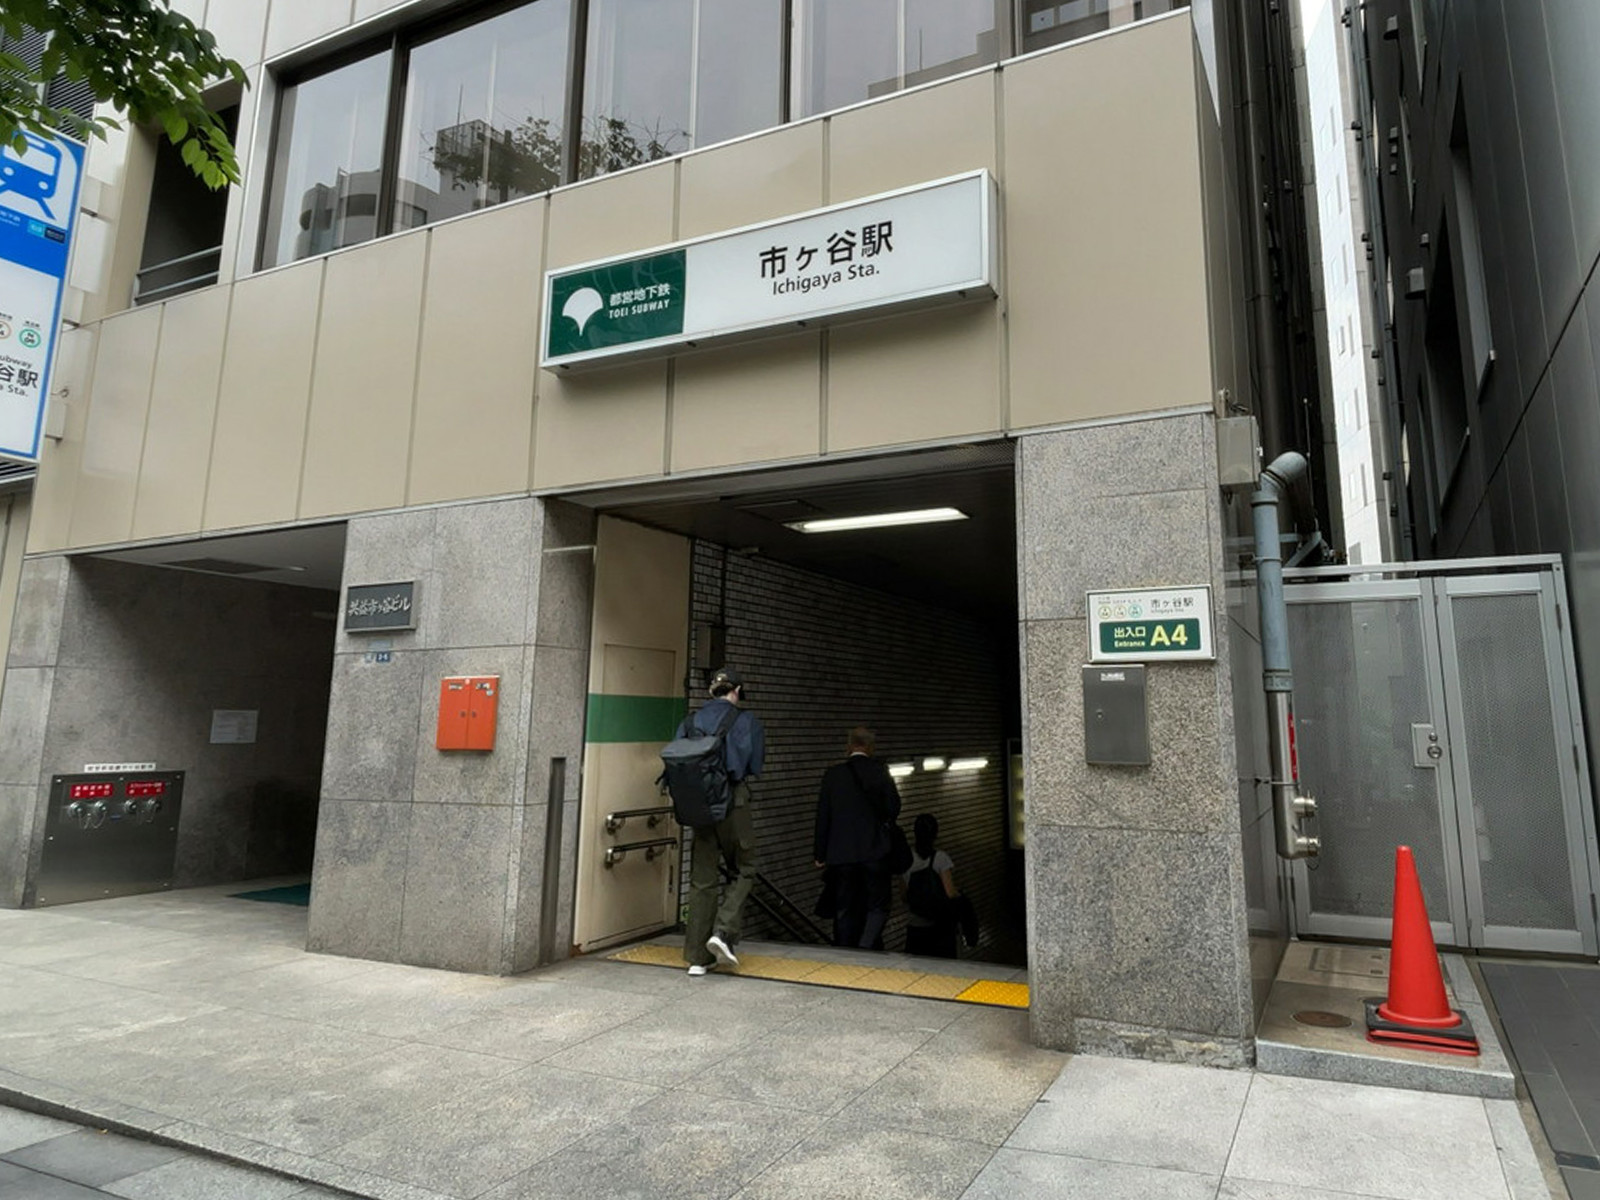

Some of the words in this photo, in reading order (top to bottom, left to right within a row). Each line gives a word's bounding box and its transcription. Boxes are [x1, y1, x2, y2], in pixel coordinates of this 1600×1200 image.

[759, 221, 893, 278] 市ヶ谷駅
[773, 271, 842, 295] Ichigaya
[848, 264, 880, 280] Sta.
[610, 283, 670, 306] 都営地下鉄
[631, 299, 670, 315] SUBWAY
[8, 384, 28, 397] Sta.
[1114, 626, 1146, 638] 出入口
[1150, 624, 1188, 646] A4
[1114, 640, 1146, 648] Entrance
